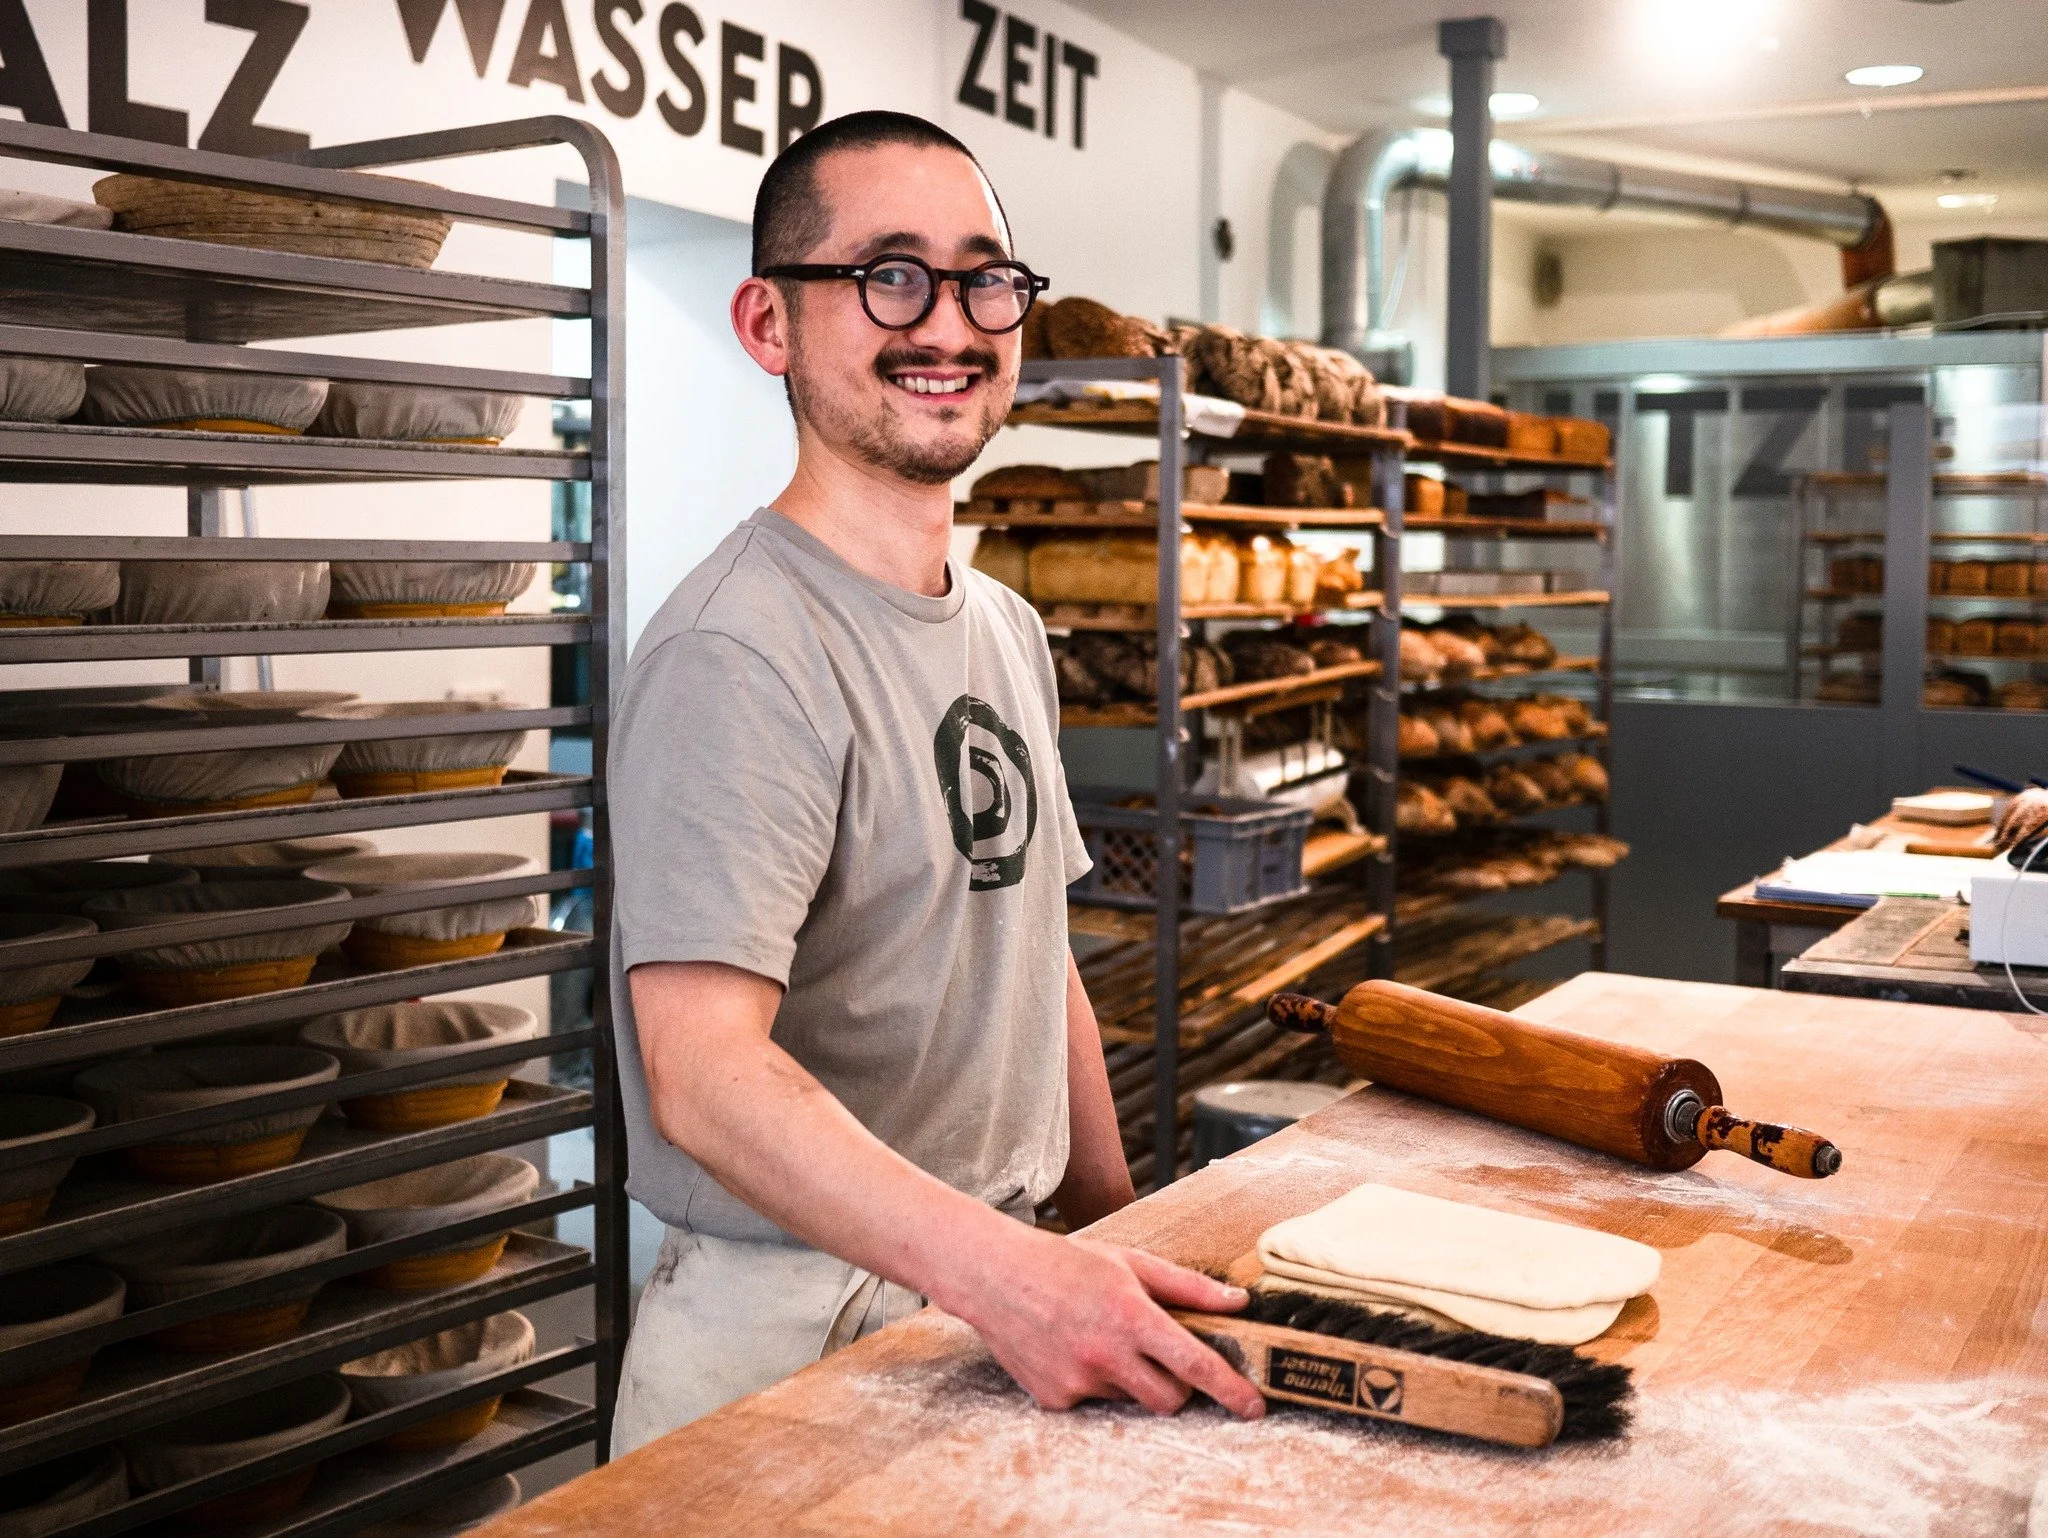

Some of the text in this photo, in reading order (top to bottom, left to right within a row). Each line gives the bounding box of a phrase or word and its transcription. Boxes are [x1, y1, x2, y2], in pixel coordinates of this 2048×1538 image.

[956, 0, 1099, 151] ZEIT
[1279, 1356, 1342, 1380] hauser
[1282, 1371, 1347, 1399] thermo
